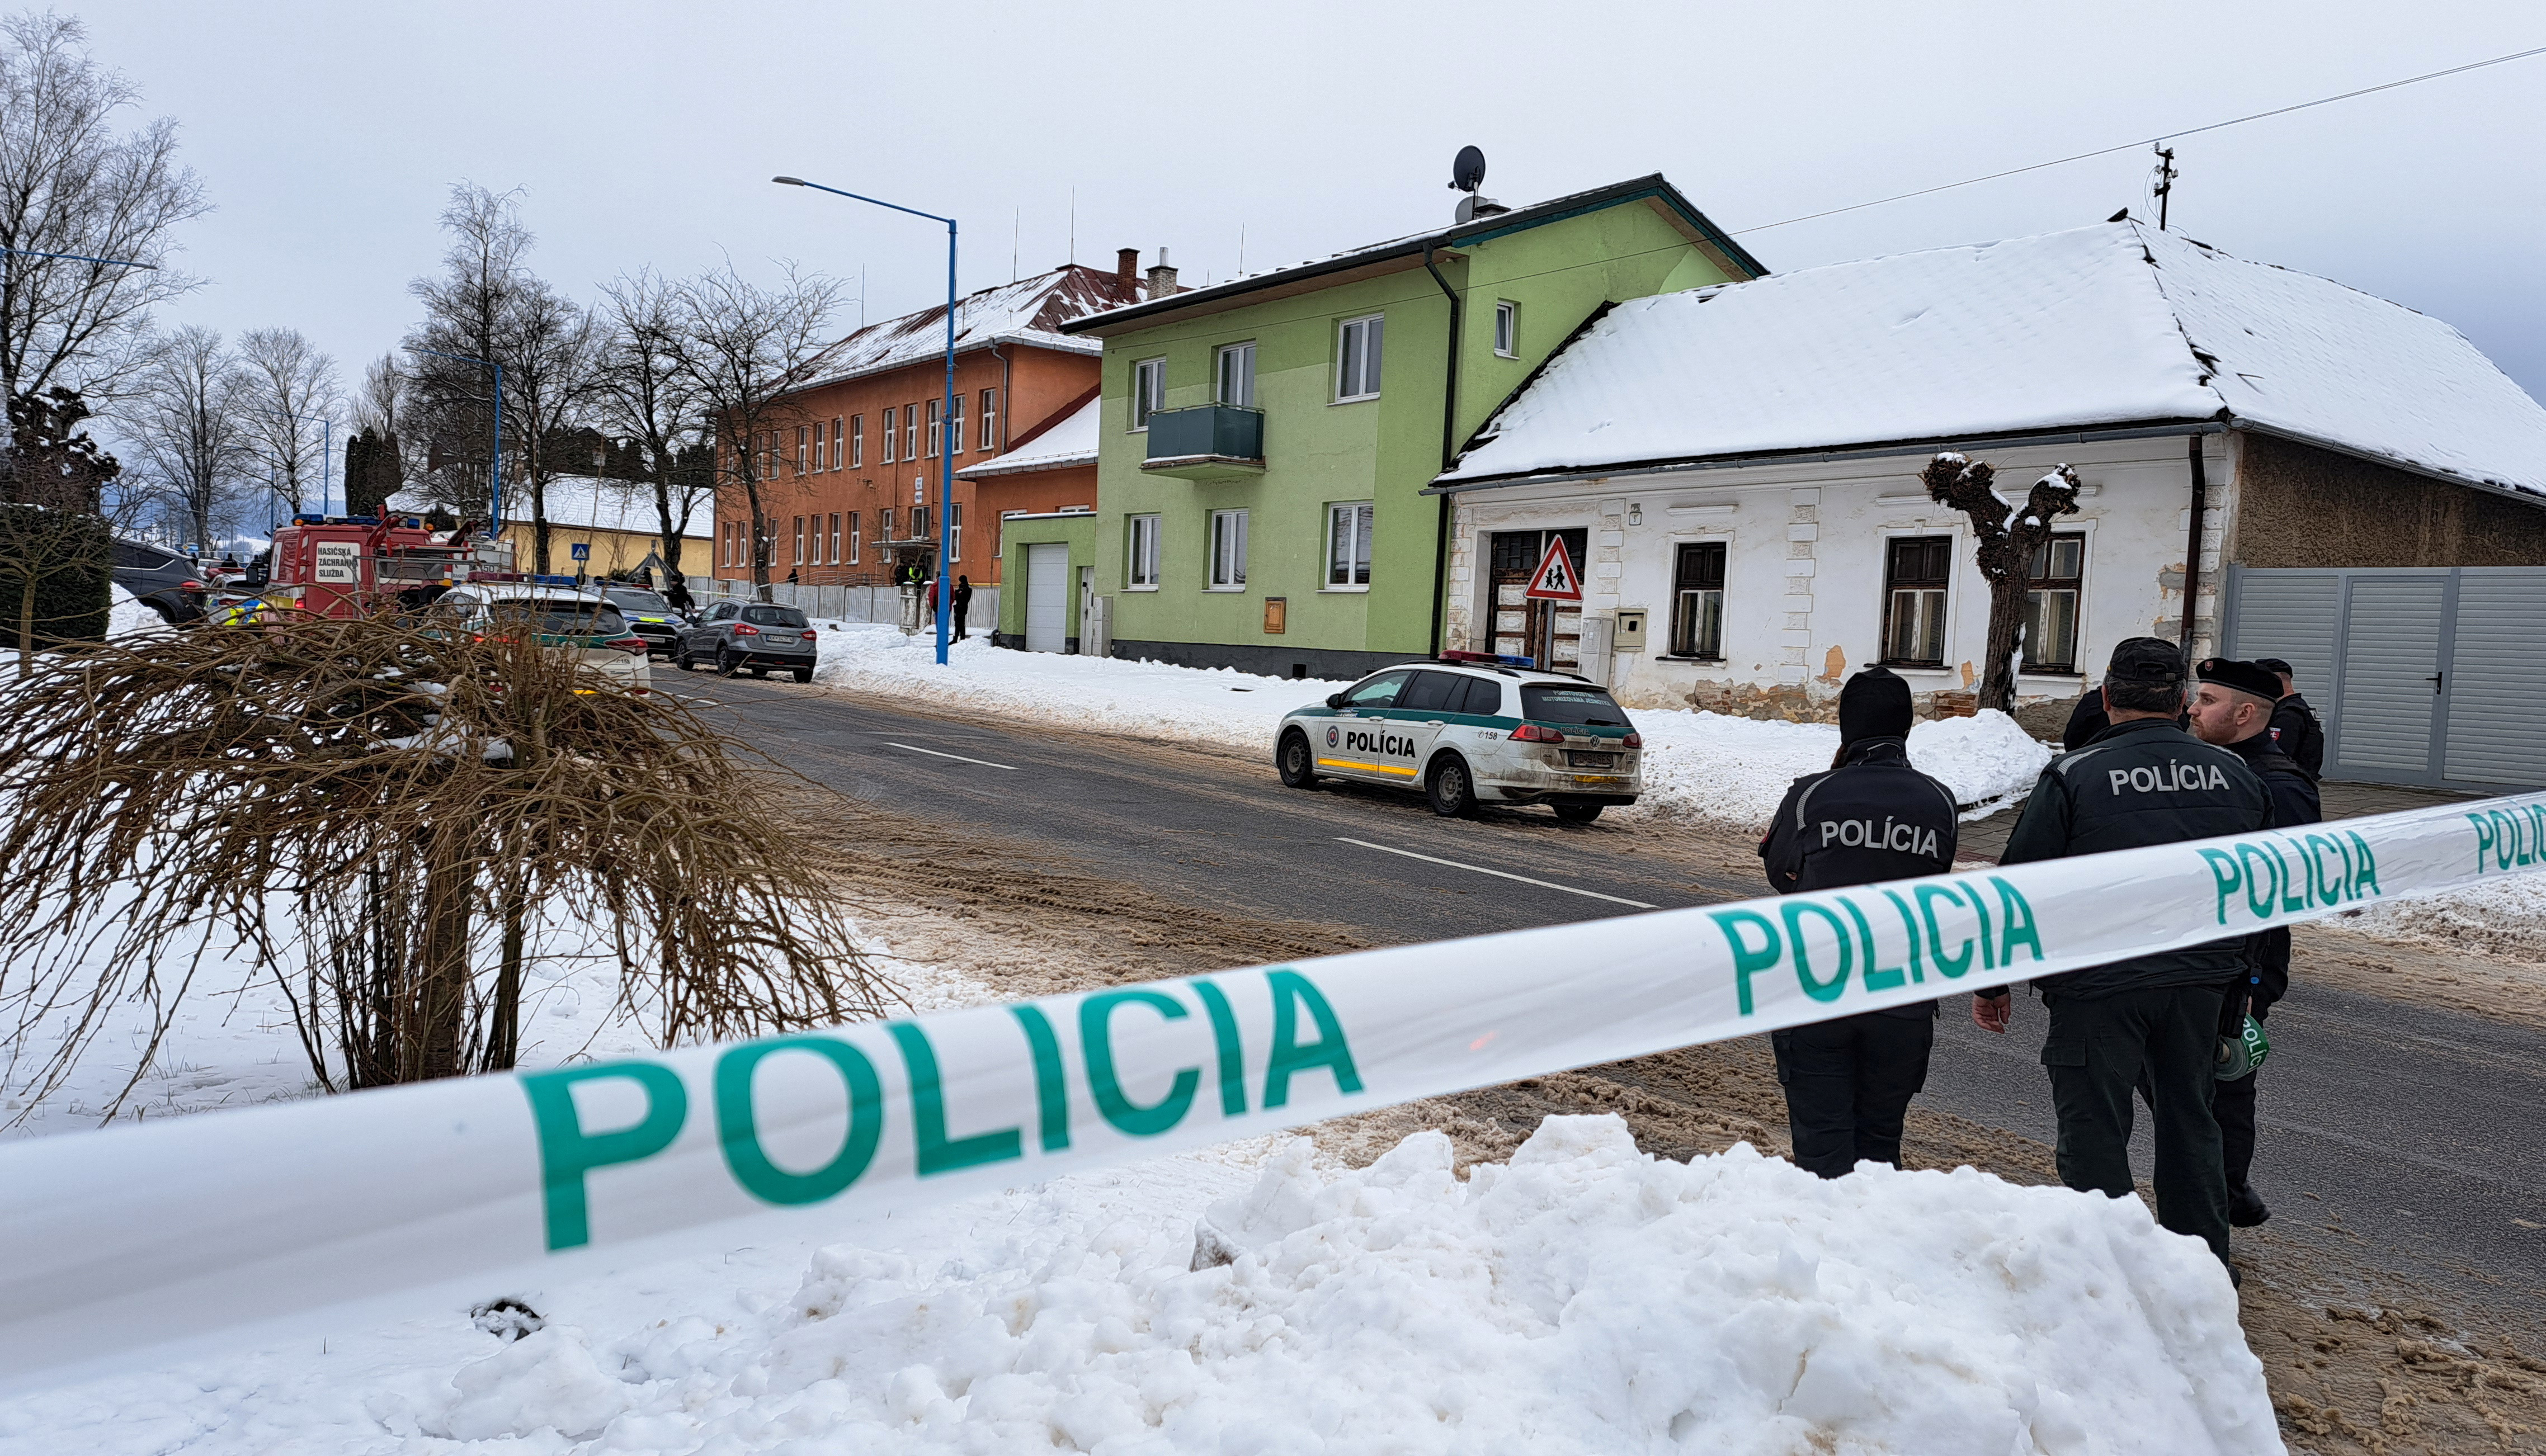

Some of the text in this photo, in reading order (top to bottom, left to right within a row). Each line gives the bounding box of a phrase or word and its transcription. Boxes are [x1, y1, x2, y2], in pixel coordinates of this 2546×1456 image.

[318, 546, 351, 556] HASIČSKÁ
[319, 569, 344, 577] SLUŽBA
[1347, 730, 1416, 758] POLÍCIA
[1485, 731, 1497, 740] 158
[2109, 759, 2230, 796] POLÍCIA
[1820, 815, 1939, 858] POLÍCIA
